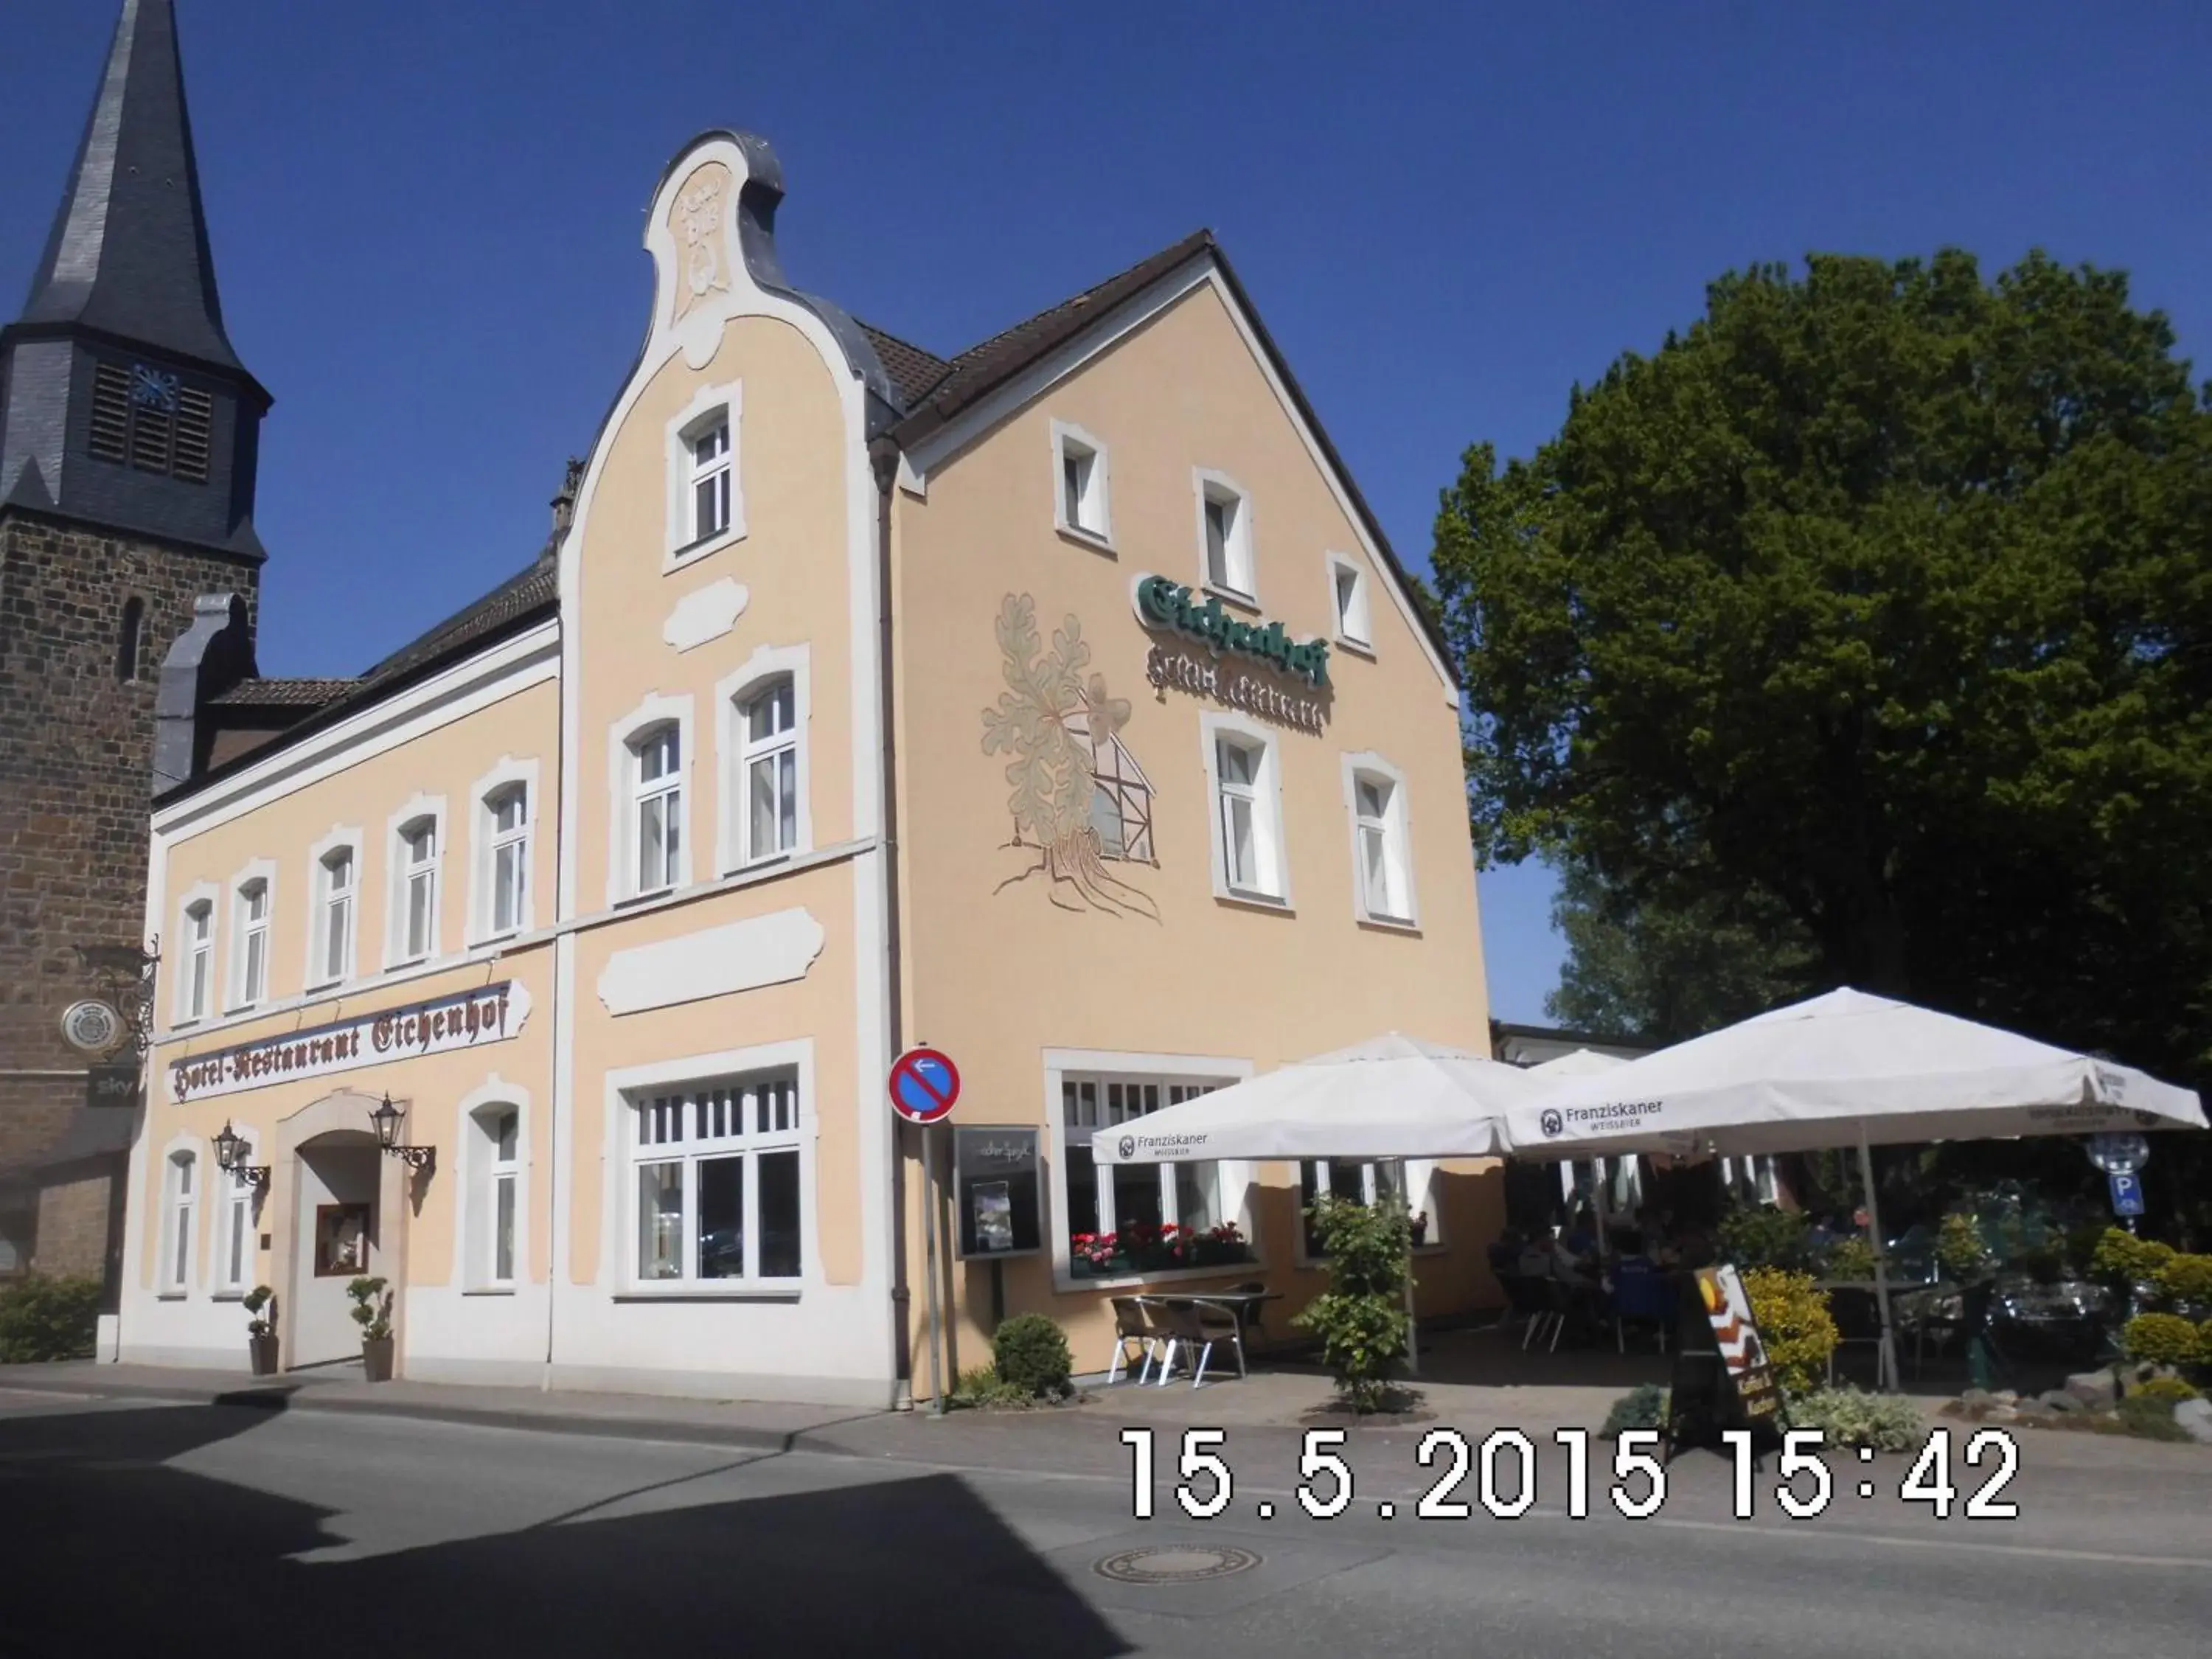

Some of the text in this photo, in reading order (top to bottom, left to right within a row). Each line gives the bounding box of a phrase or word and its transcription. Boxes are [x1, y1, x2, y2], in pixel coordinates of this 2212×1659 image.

[1138, 574, 1330, 686] Eichenhof
[173, 986, 510, 1104] Hotel-Restaurant Eichenhof
[97, 1077, 133, 1096] sky
[1566, 1100, 1663, 1121] Franziskaner
[1138, 1134, 1208, 1147] Franziskaner
[2117, 1177, 2133, 1196] P
